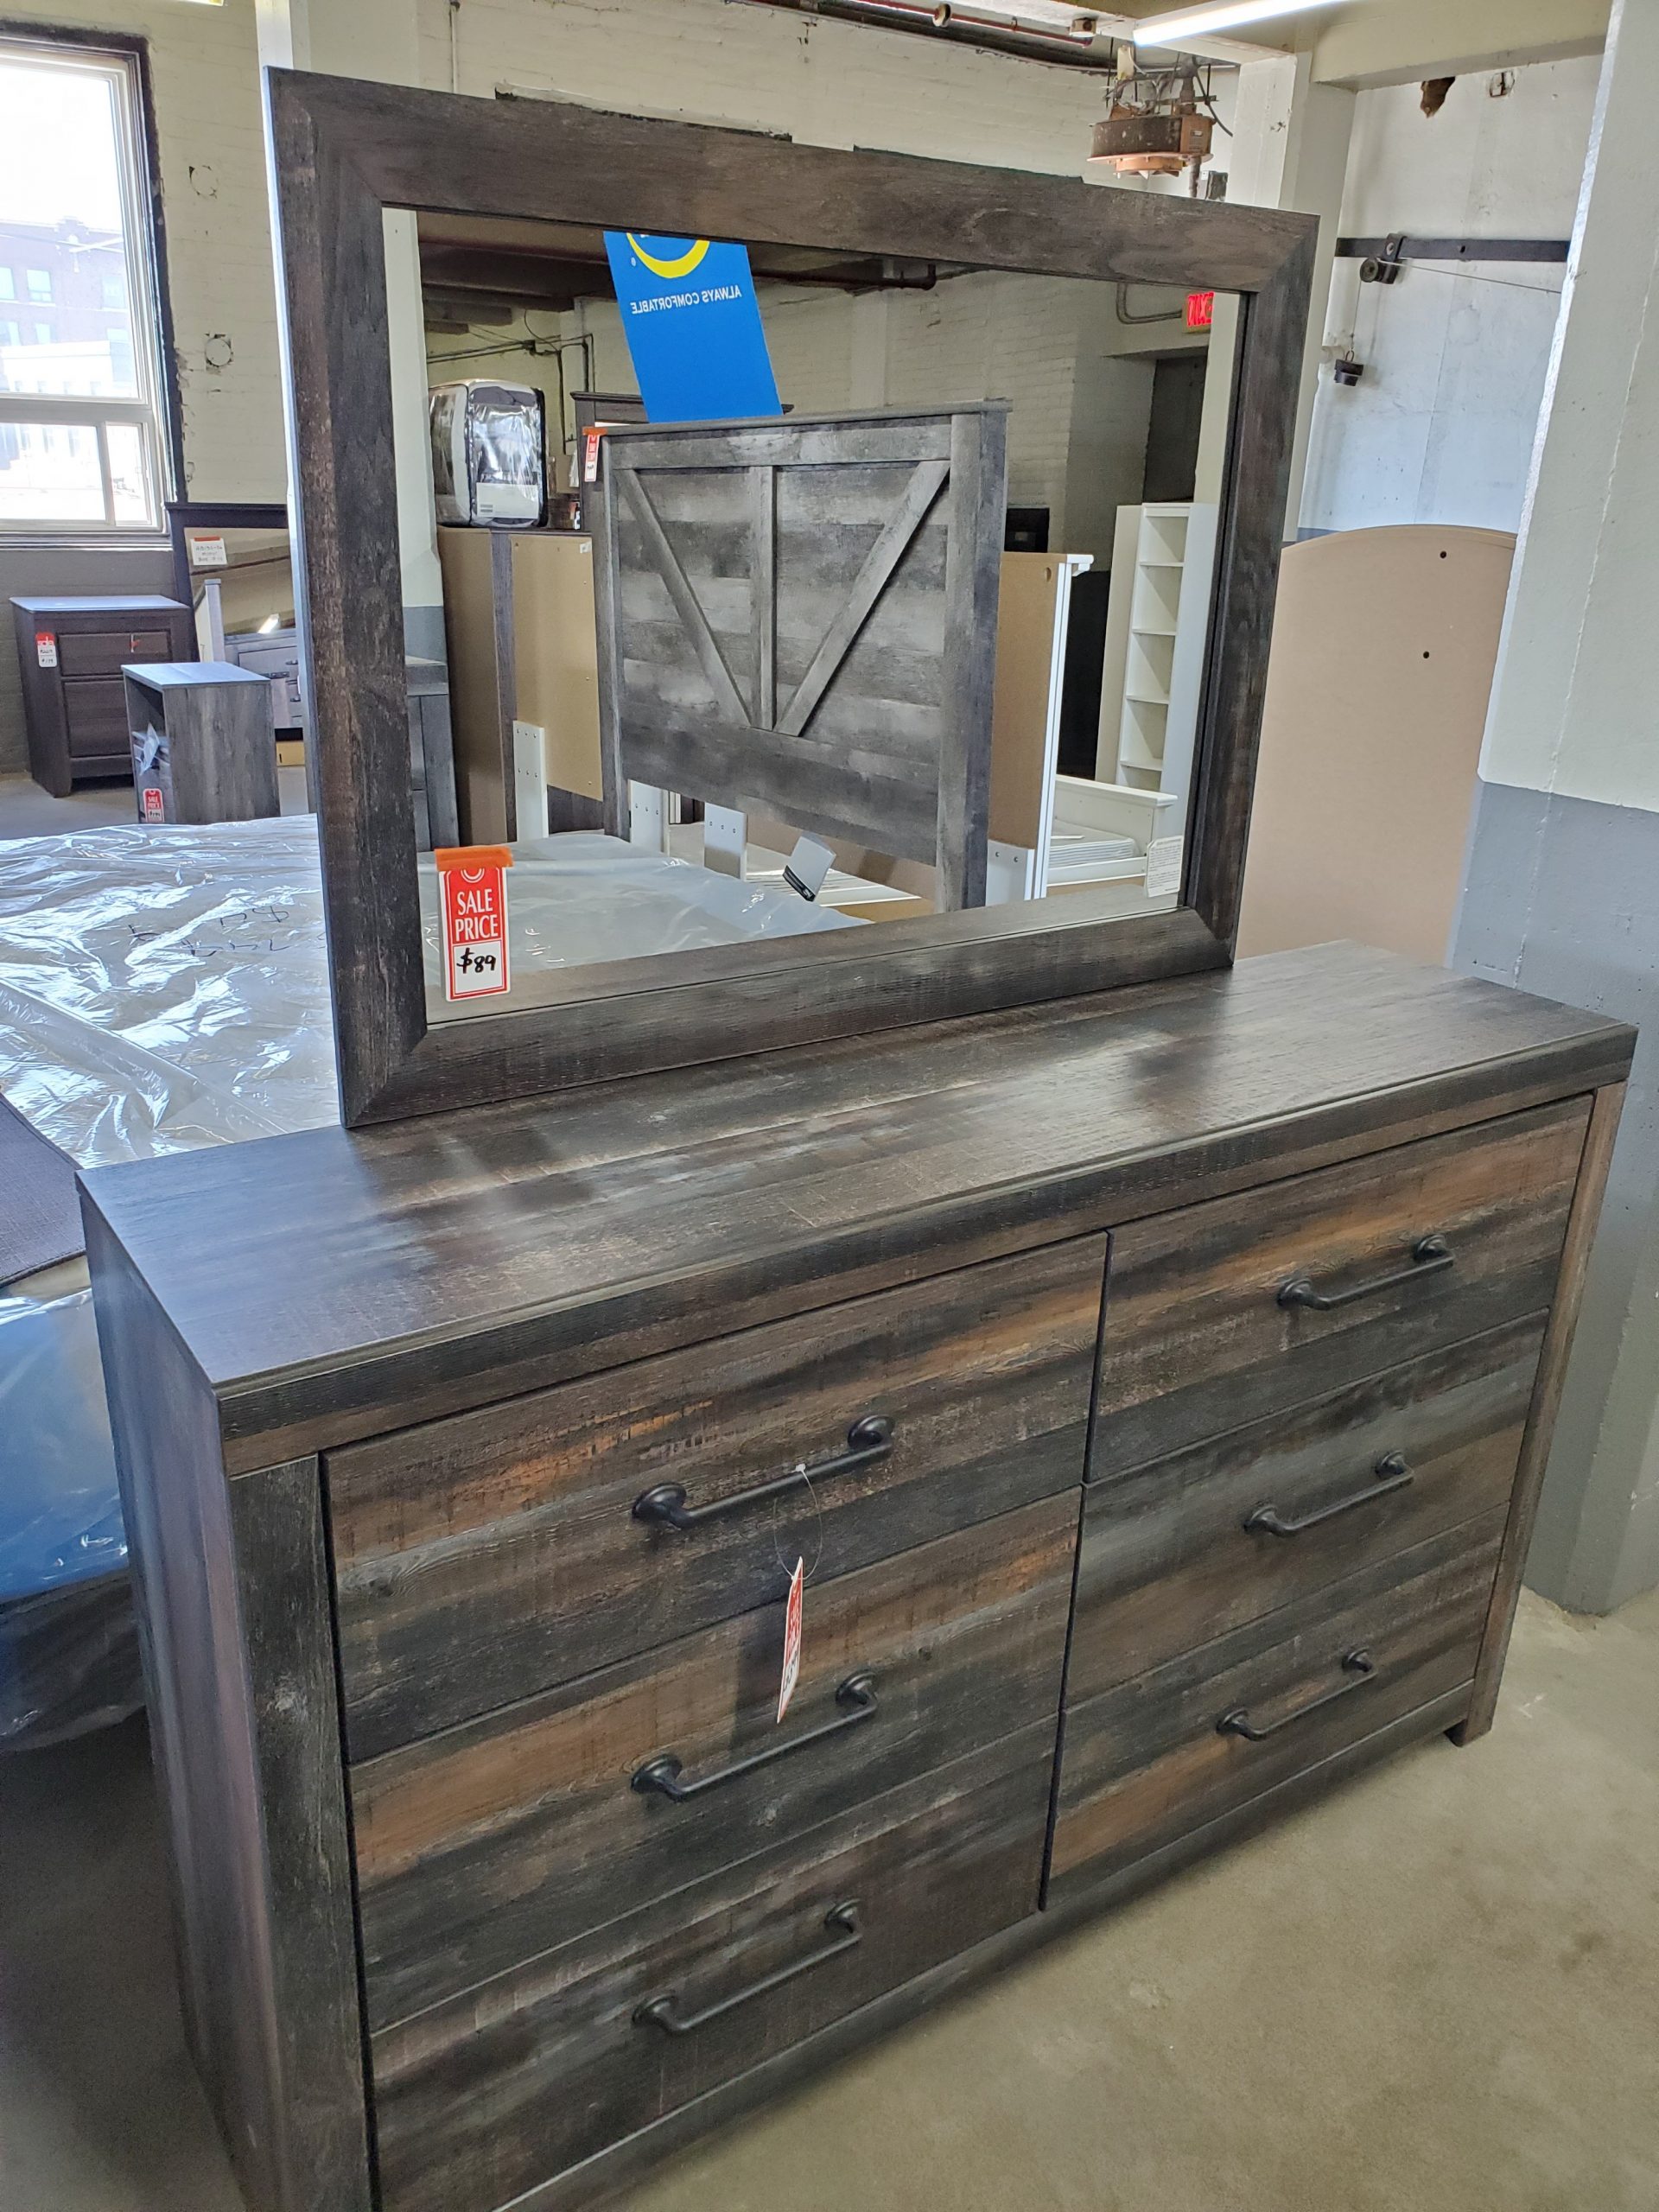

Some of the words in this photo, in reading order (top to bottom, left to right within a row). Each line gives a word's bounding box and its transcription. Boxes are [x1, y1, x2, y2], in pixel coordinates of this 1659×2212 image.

[457, 888, 493, 916] SALE
[454, 914, 499, 942] PRICE
[456, 947, 497, 975] $89
